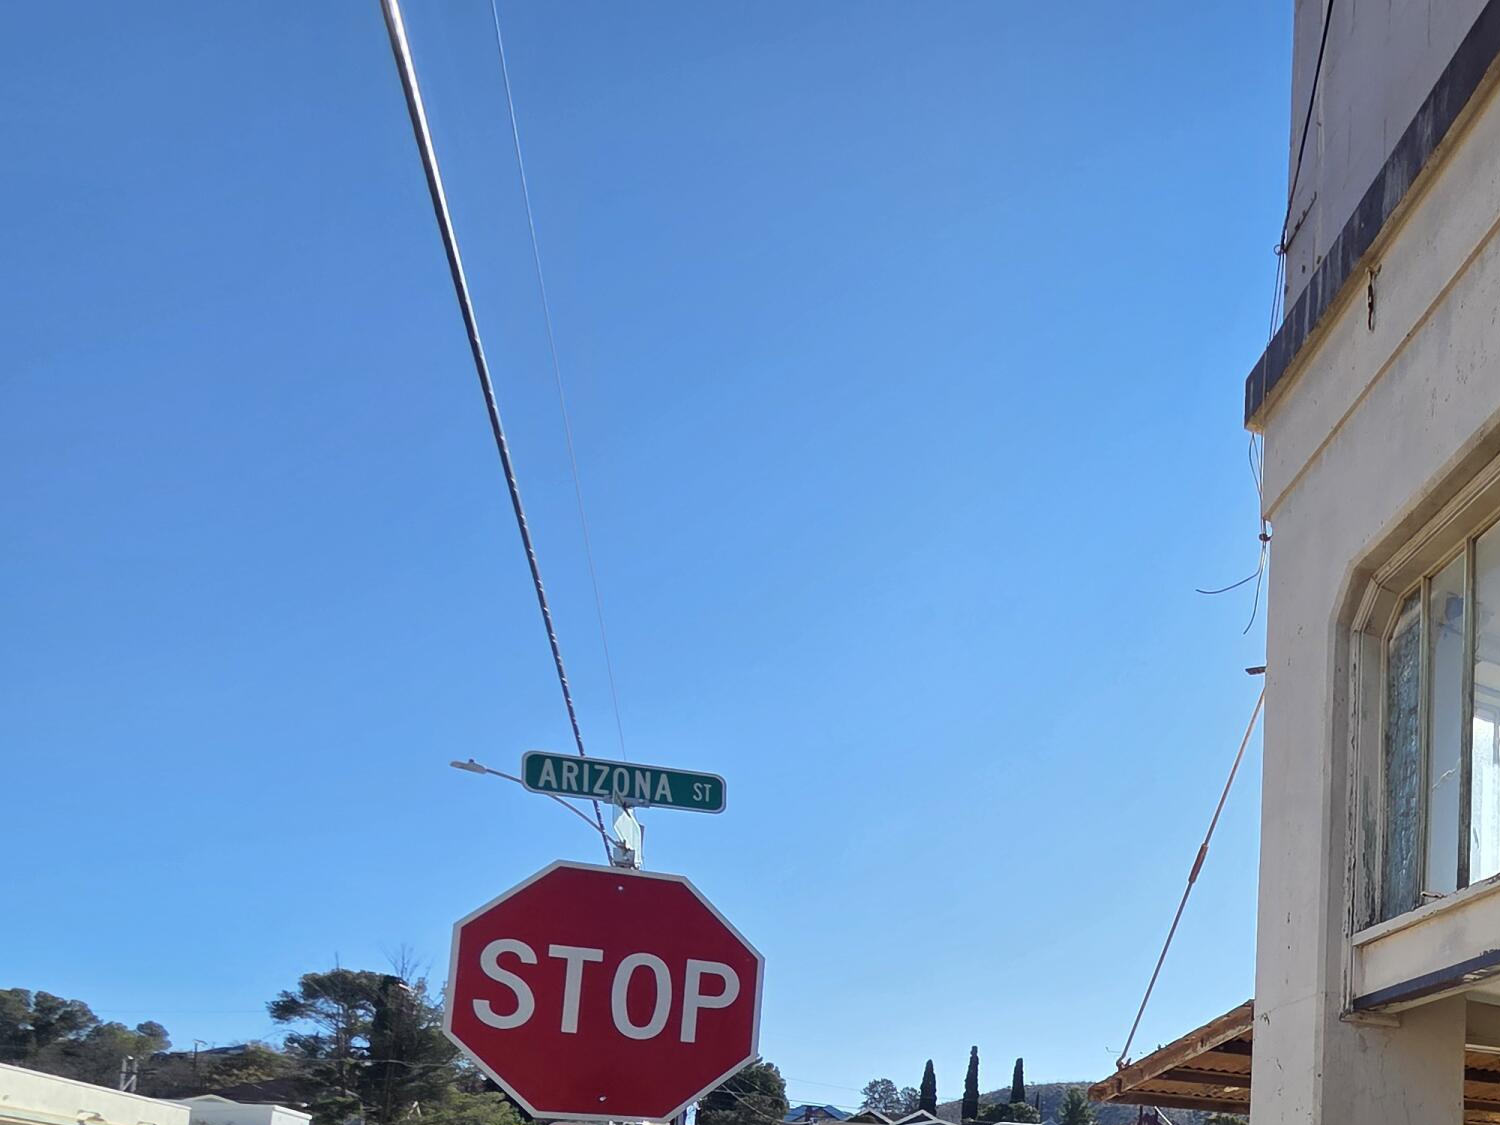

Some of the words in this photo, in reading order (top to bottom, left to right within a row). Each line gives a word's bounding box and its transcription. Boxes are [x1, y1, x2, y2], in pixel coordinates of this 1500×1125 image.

[538, 758, 673, 803] ARIZONA
[692, 782, 712, 802] ST
[472, 938, 741, 1044] STOP
